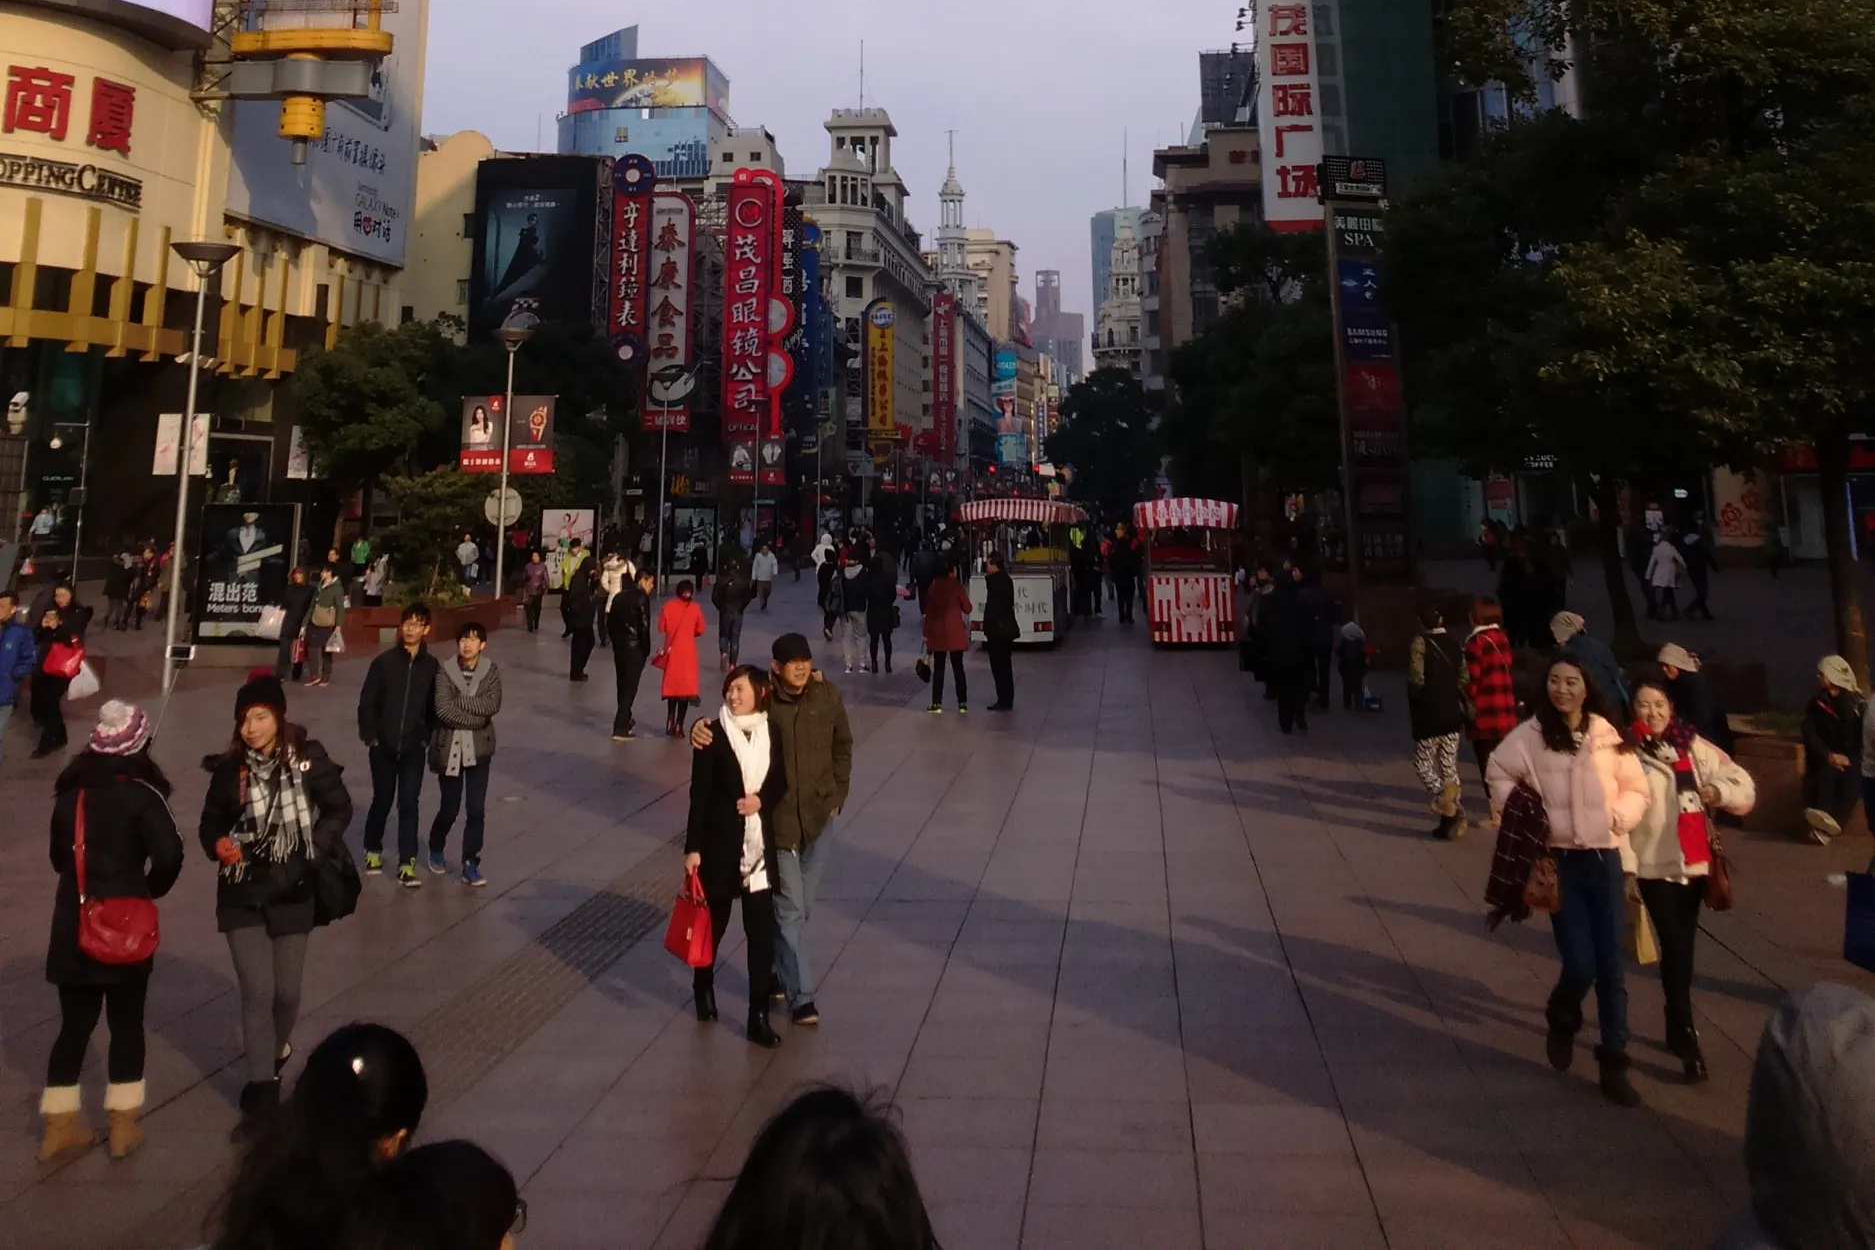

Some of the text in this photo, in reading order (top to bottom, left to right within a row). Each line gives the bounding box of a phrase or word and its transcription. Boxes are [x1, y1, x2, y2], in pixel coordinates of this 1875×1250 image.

[1344, 232, 1375, 247] SPA
[651, 217, 686, 360] 泰康食品
[729, 234, 762, 413] 茂昌眼镜公司
[1346, 327, 1388, 338] SAMSUNG
[208, 582, 259, 603] 混出范
